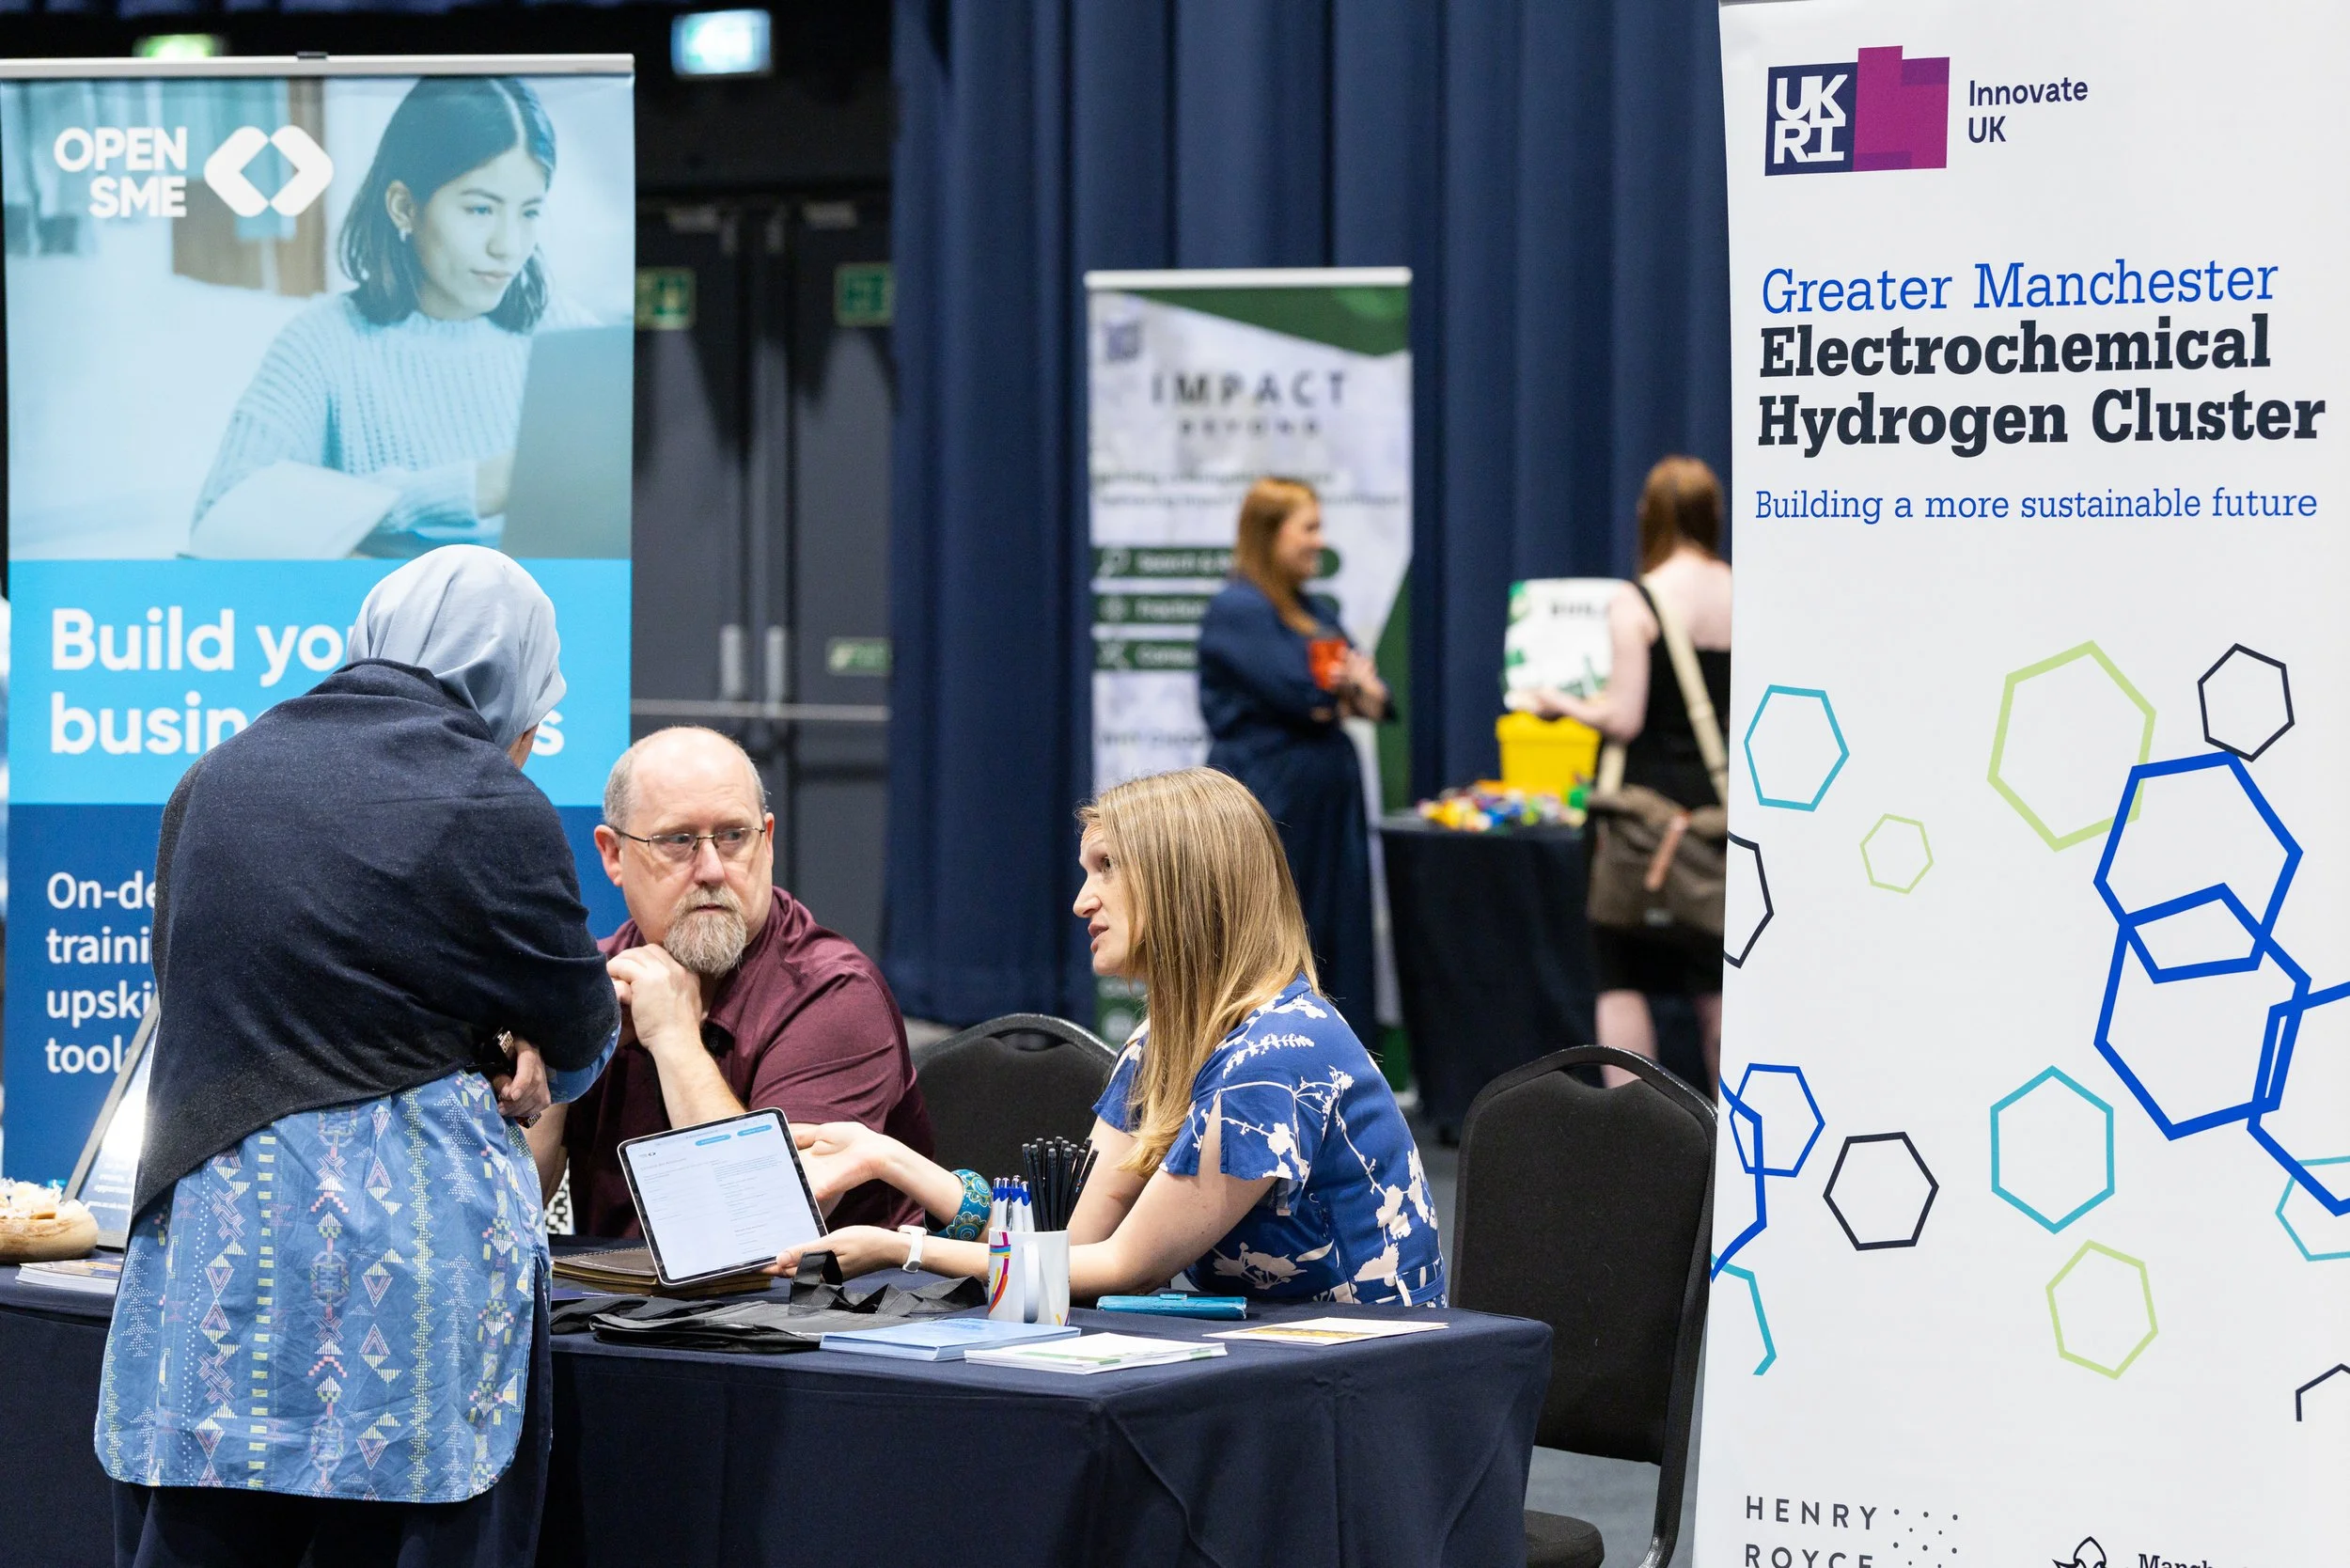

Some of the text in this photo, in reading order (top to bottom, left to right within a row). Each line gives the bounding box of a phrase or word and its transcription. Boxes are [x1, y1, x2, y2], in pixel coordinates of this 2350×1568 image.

[1776, 74, 1848, 125] UK
[1970, 77, 2089, 106] Innovate
[54, 127, 186, 172] OPEN
[1969, 116, 2007, 143] UK
[89, 177, 186, 218] SME
[1763, 259, 2279, 314] Greater Manchester
[1760, 313, 2270, 378] Electrochemical
[1152, 370, 1345, 406] IMPACT
[1759, 387, 2326, 458] Hydrogen Cluster
[1756, 487, 2317, 525] Building a more sustainable future
[53, 606, 352, 687] Build yo
[52, 692, 254, 755] busin
[46, 926, 149, 964] traini
[47, 980, 151, 1028] upski
[45, 1035, 129, 1074] tool
[1747, 1496, 1877, 1530] HENRY
